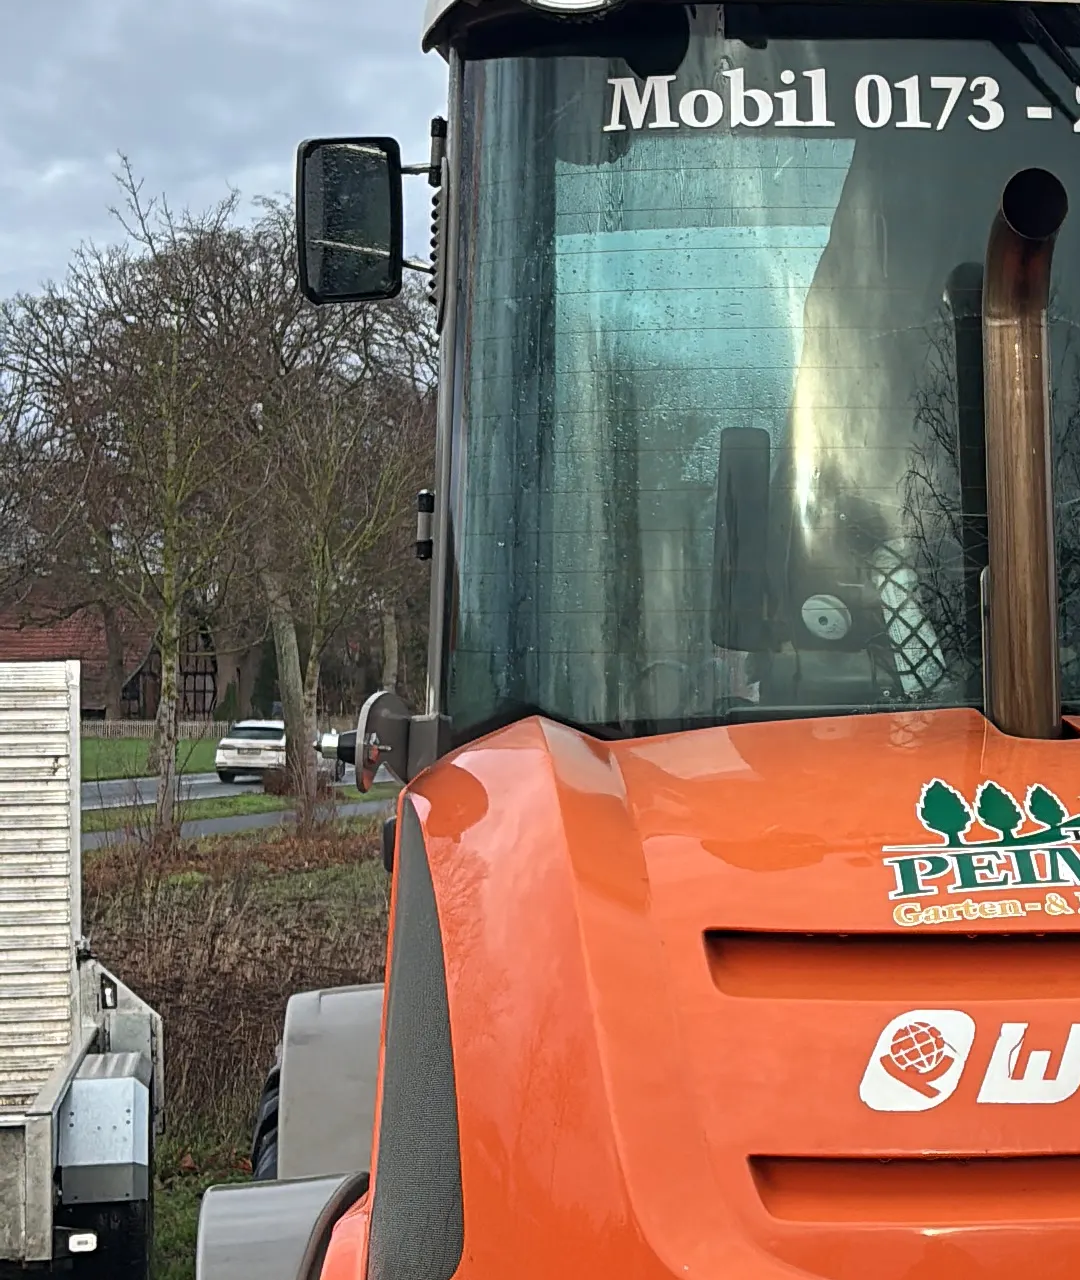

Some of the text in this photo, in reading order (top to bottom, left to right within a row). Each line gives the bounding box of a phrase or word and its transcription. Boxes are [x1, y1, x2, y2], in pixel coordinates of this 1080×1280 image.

[603, 68, 836, 132] Mobil
[854, 75, 1005, 131] 0173
[1026, 106, 1053, 120] -
[893, 896, 1040, 926] Garten-
[1044, 892, 1070, 915] &
